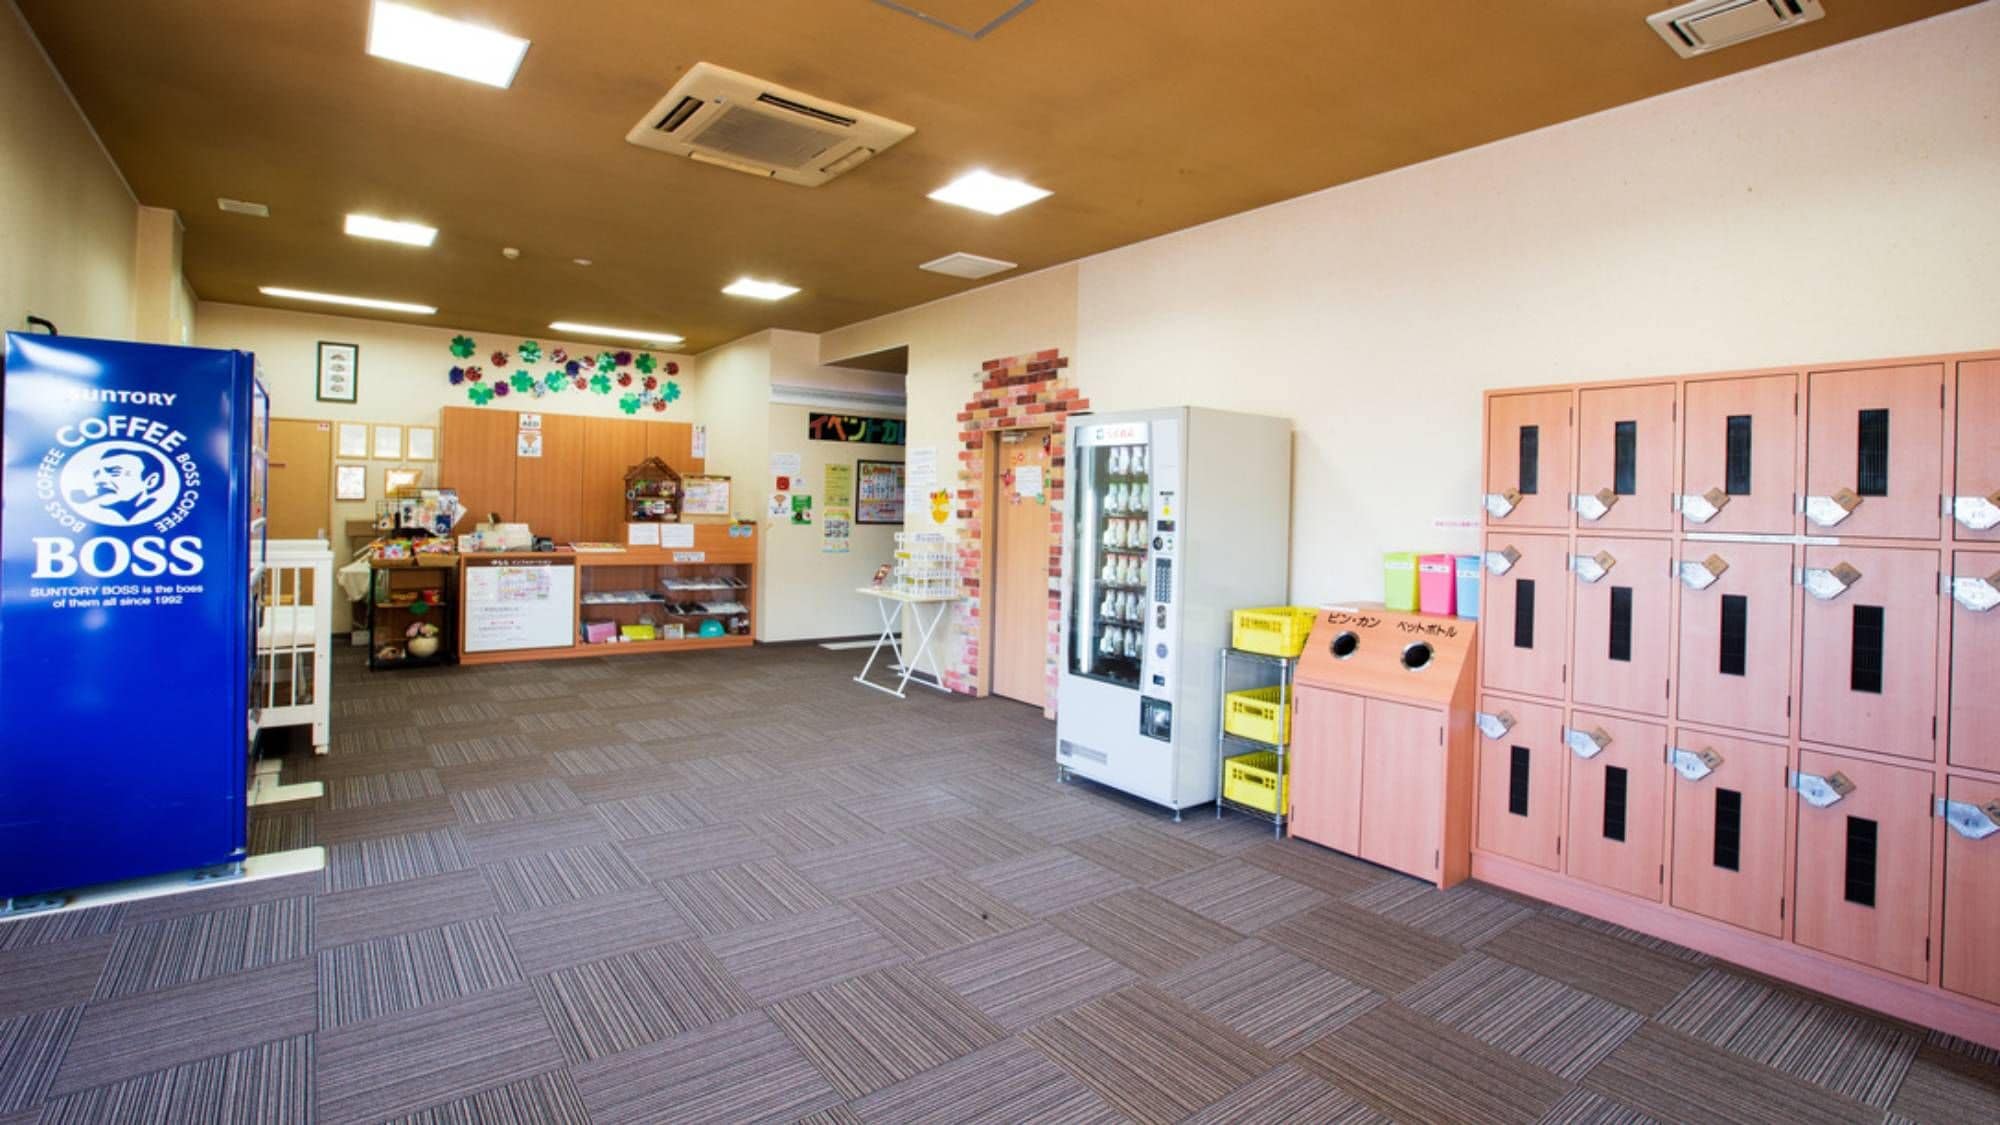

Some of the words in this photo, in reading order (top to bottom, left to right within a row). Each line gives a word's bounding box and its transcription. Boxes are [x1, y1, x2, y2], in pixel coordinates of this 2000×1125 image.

[66, 389, 177, 406] UNTORY
[56, 415, 187, 453] COFFEE
[37, 448, 65, 500] COFFEE
[176, 452, 201, 487] BOSS
[45, 501, 86, 534] BOSS
[154, 491, 199, 533] COFFEE
[32, 535, 204, 578] BOSS
[30, 586, 98, 597] SUNTORY
[102, 585, 139, 595] BOSS
[142, 585, 152, 594] is
[154, 584, 173, 593] the
[176, 584, 203, 593] boss
[53, 598, 66, 608] of
[69, 597, 100, 607] them
[102, 596, 116, 606] all
[119, 596, 150, 606] since
[155, 595, 183, 605] 1992
